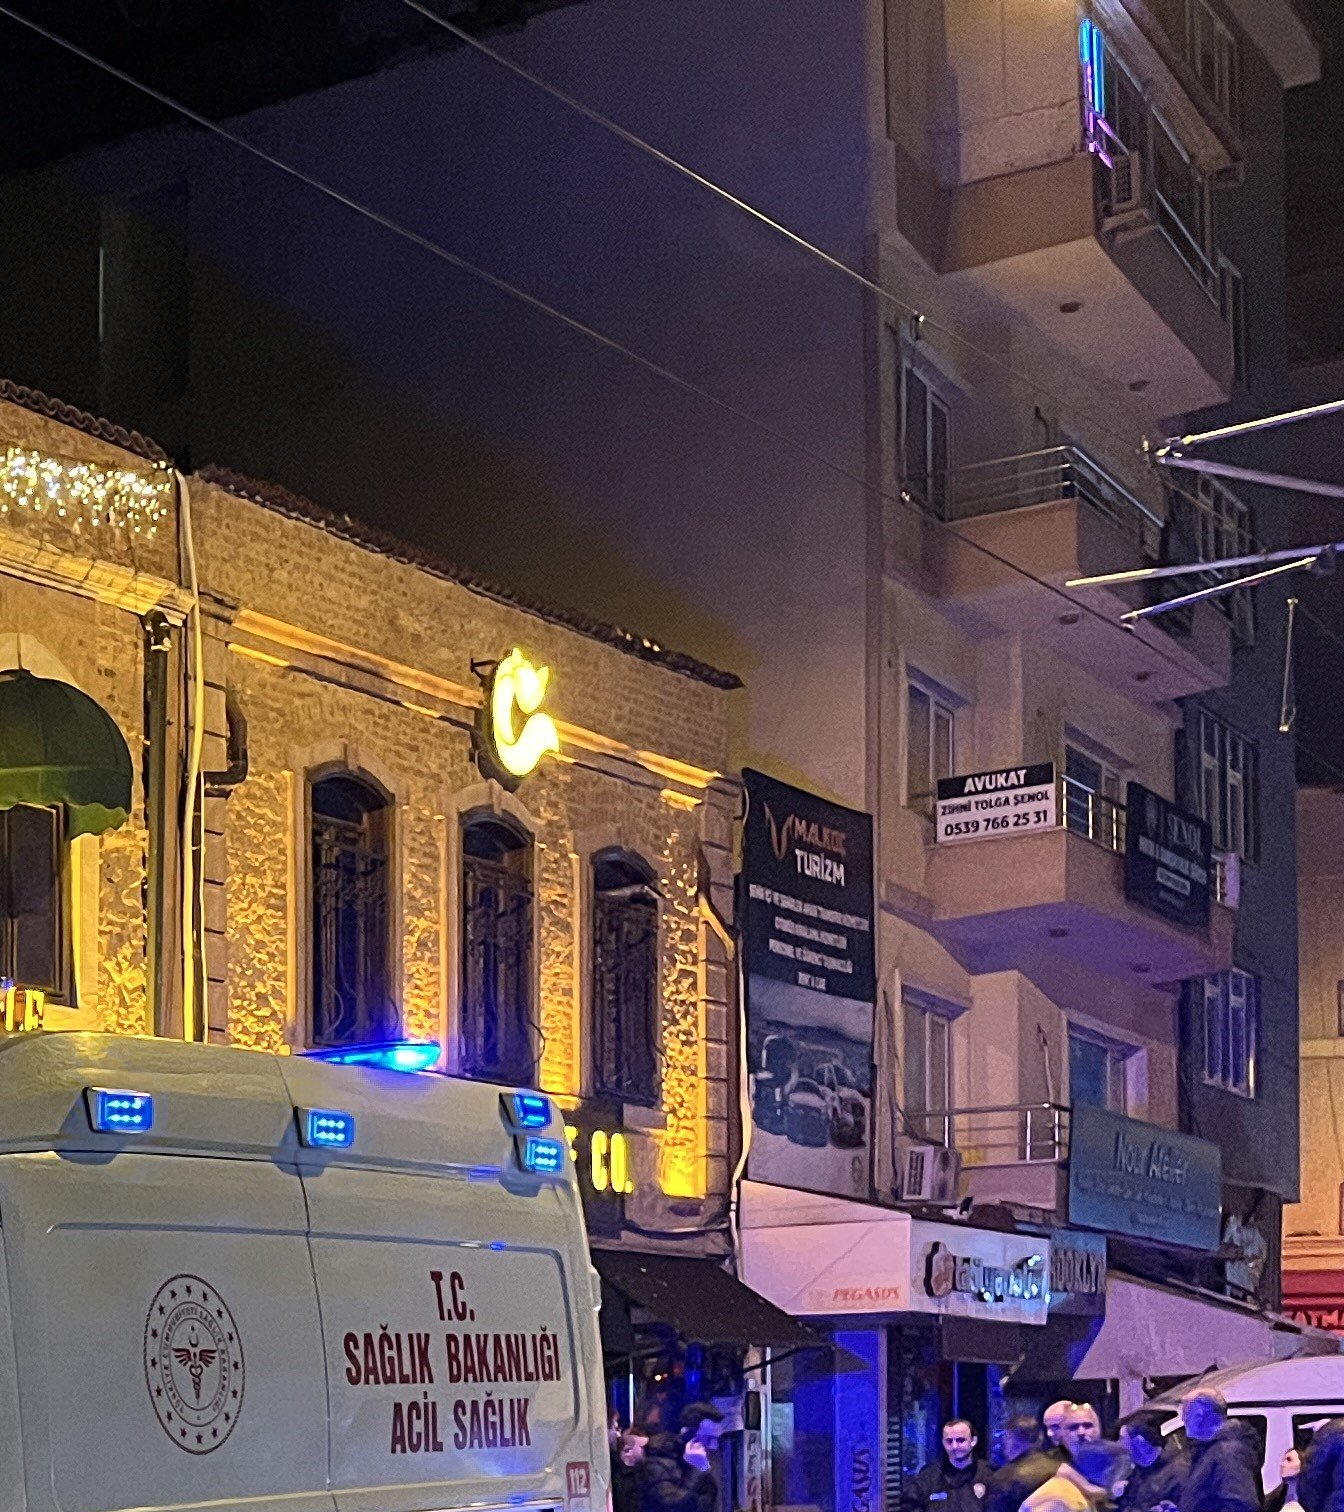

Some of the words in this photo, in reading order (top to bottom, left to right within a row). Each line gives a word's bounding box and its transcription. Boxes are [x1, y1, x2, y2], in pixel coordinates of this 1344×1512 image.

[963, 769, 1027, 794] AVUKAT
[944, 820, 980, 836] 0539
[983, 815, 1010, 831] 766
[1013, 812, 1030, 826] 25
[1033, 809, 1048, 824] 31
[975, 796, 1011, 811] TOLGA
[794, 848, 846, 887] TURİZM
[430, 1270, 475, 1322] T.C.
[343, 1323, 434, 1386] SAĞLIK
[445, 1325, 561, 1384] BAKANLIĞI
[390, 1391, 444, 1454] ACİL
[453, 1390, 532, 1450] SAĞLIK
